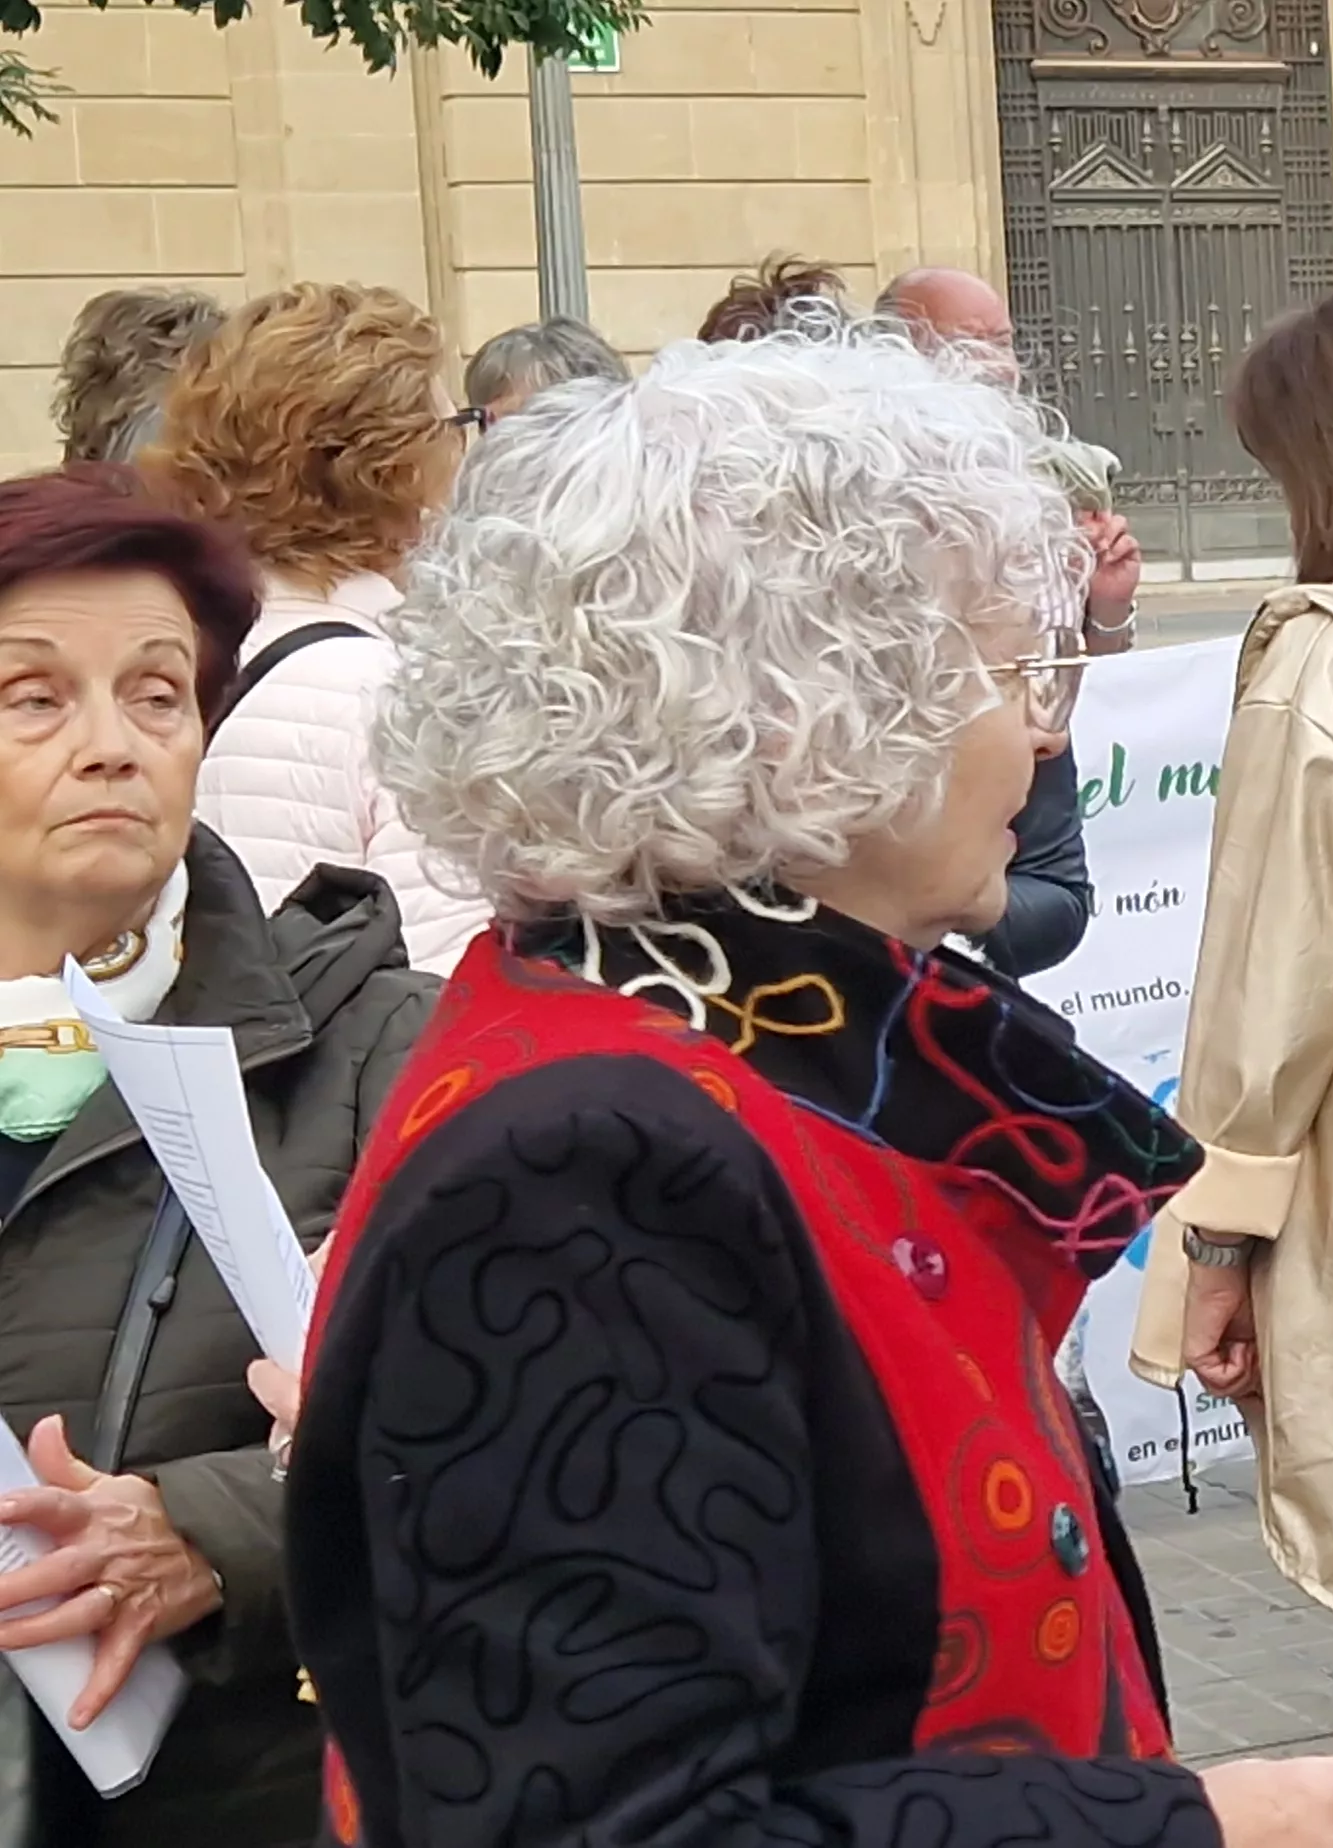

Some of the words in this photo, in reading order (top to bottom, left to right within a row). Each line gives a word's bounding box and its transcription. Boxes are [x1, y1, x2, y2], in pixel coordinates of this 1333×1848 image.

[1116, 880, 1186, 915] món
[1061, 991, 1083, 1015] el
[1091, 977, 1189, 1011] mundo.
[1127, 1440, 1157, 1461] en
